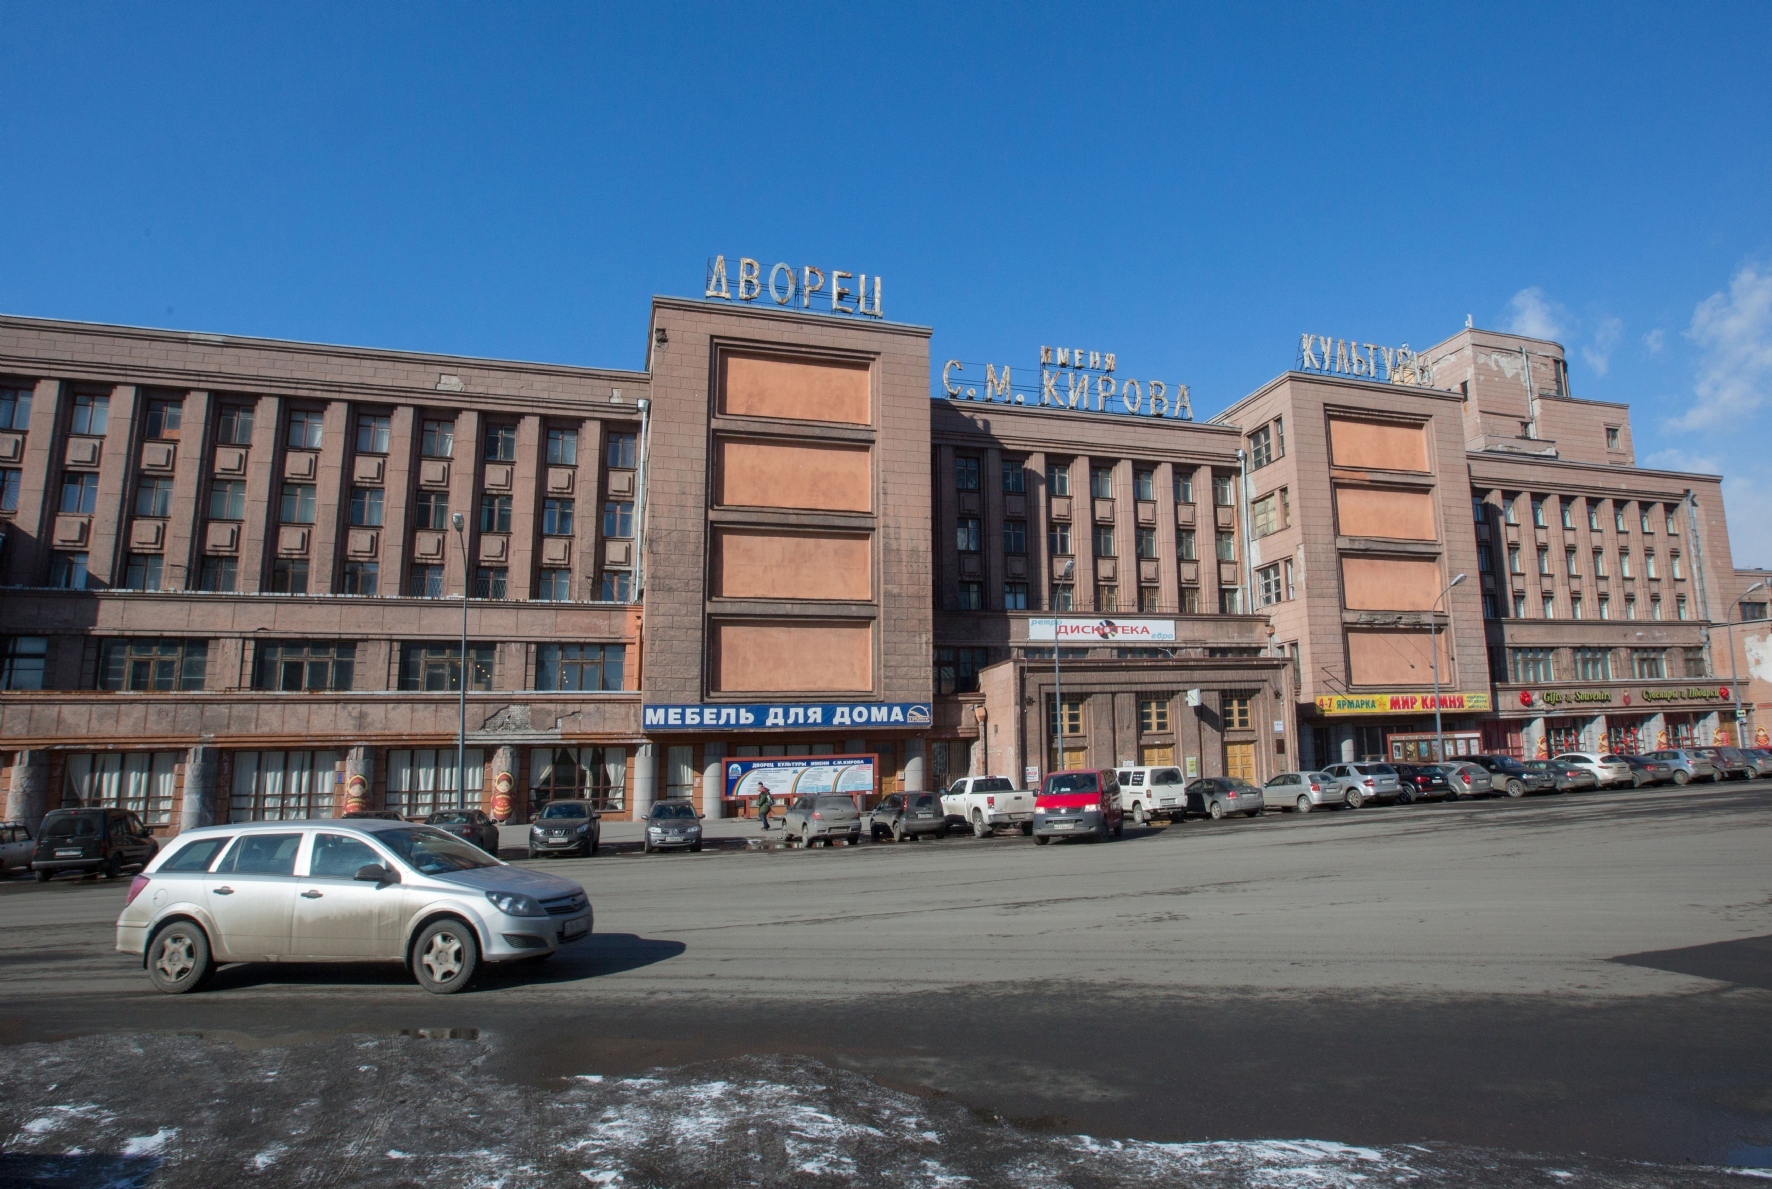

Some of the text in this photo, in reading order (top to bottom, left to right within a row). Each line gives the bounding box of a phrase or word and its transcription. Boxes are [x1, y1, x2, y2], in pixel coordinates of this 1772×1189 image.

[705, 254, 883, 318] ДВОРЕЦ
[1040, 345, 1116, 371] ИМЕНИ
[1302, 333, 1435, 387] КУЛЬТУРЫ
[1042, 369, 1194, 420] КИРОВА
[1057, 625, 1150, 636] ДИСКОТЕКА
[1151, 632, 1174, 641] евро
[1336, 699, 1377, 709] ЯРМАРКА
[1389, 695, 1418, 710] МИР
[1421, 695, 1464, 709] КАМНЯ
[1575, 691, 1612, 703] Souvenirs
[645, 706, 905, 726] МЕБЕЛЬ ДЛЯ ДОМА
